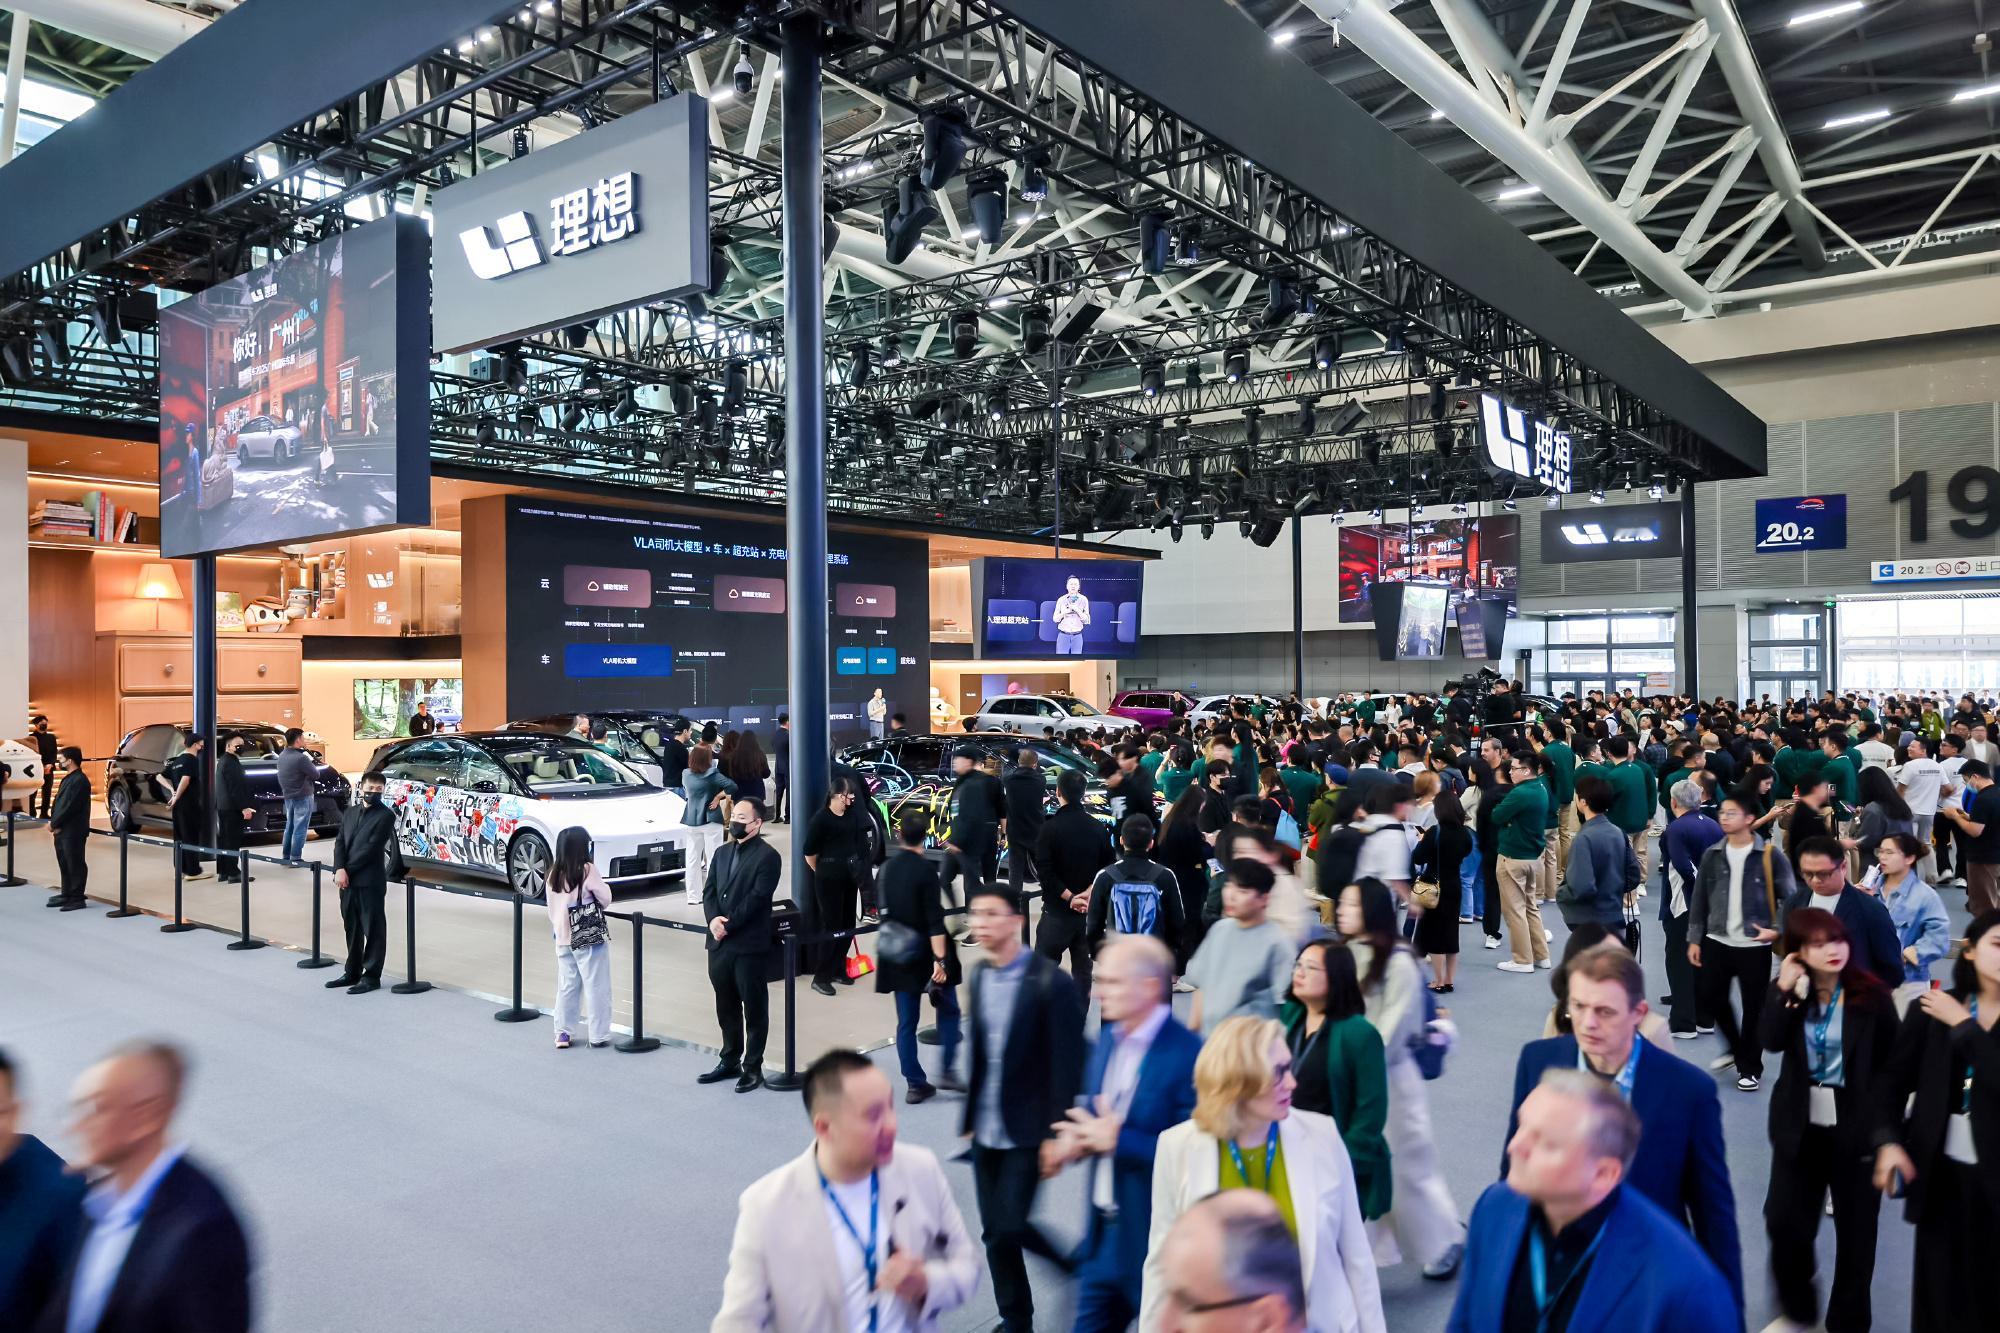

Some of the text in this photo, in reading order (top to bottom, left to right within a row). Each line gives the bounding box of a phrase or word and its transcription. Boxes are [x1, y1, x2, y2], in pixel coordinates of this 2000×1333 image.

[550, 171, 638, 255] 理想
[1534, 421, 1572, 494] 理想
[1889, 465, 2000, 542] 19
[1767, 522, 1815, 542] 20.2
[634, 536, 703, 554] VLA司机大模型
[713, 543, 723, 555] 车
[732, 544, 759, 558] 超充站
[768, 547, 788, 560] 充电
[1900, 565, 1925, 575] 20.2
[1975, 560, 2000, 572] 出口
[541, 578, 550, 588] 云
[541, 653, 550, 665] 车
